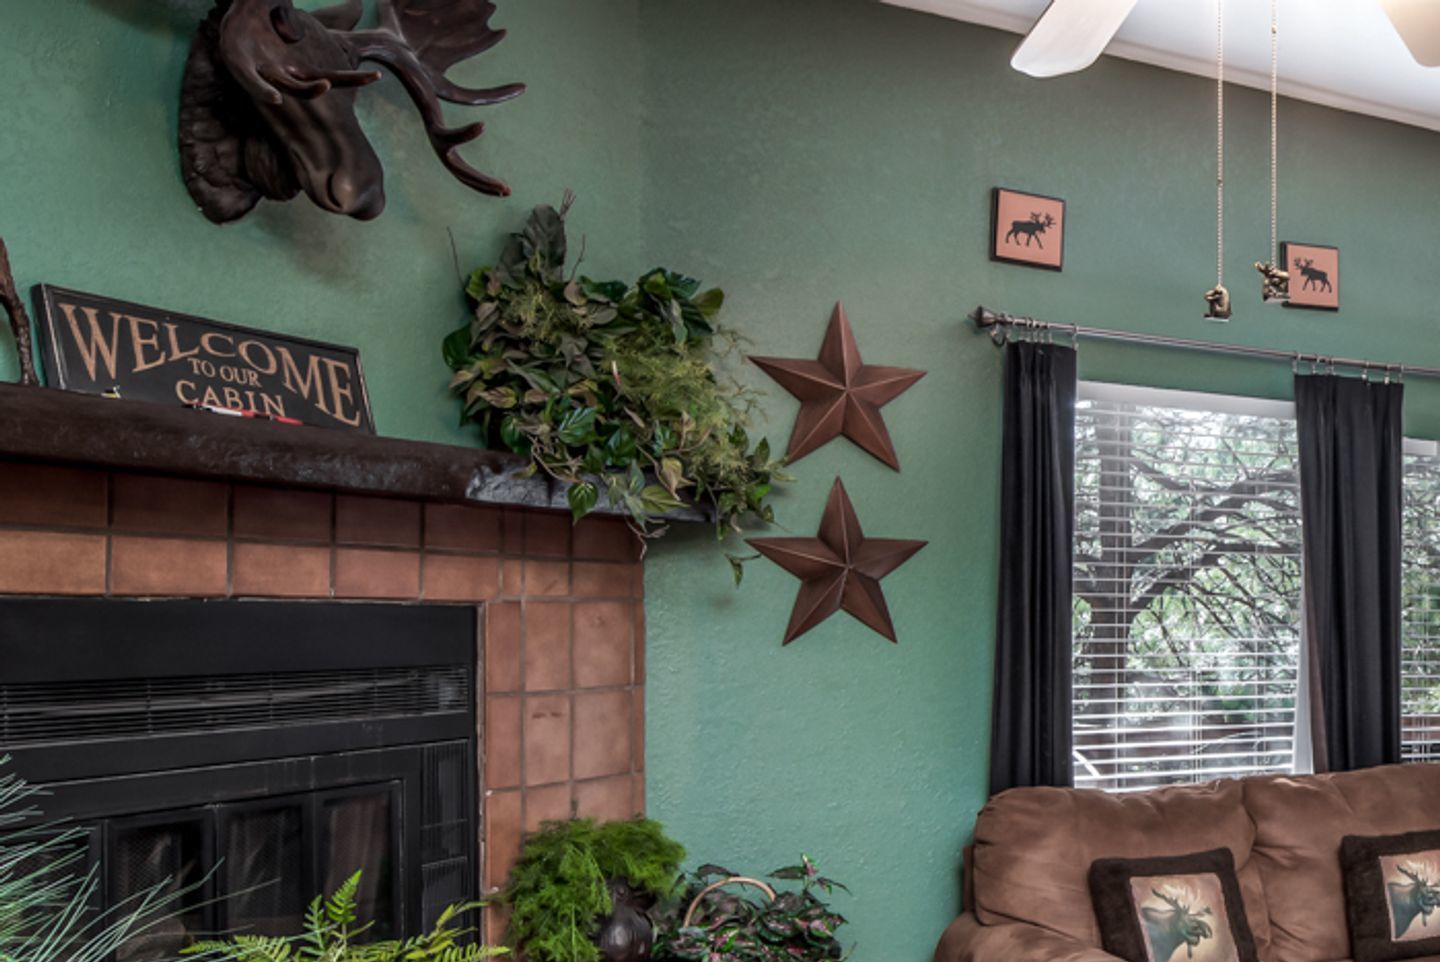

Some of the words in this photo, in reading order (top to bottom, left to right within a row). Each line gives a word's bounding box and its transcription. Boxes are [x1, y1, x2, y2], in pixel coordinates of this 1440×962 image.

[58, 303, 361, 428] WELCOME
[187, 357, 216, 378] TO
[220, 365, 262, 388] OUR
[175, 379, 286, 418] CABIN
